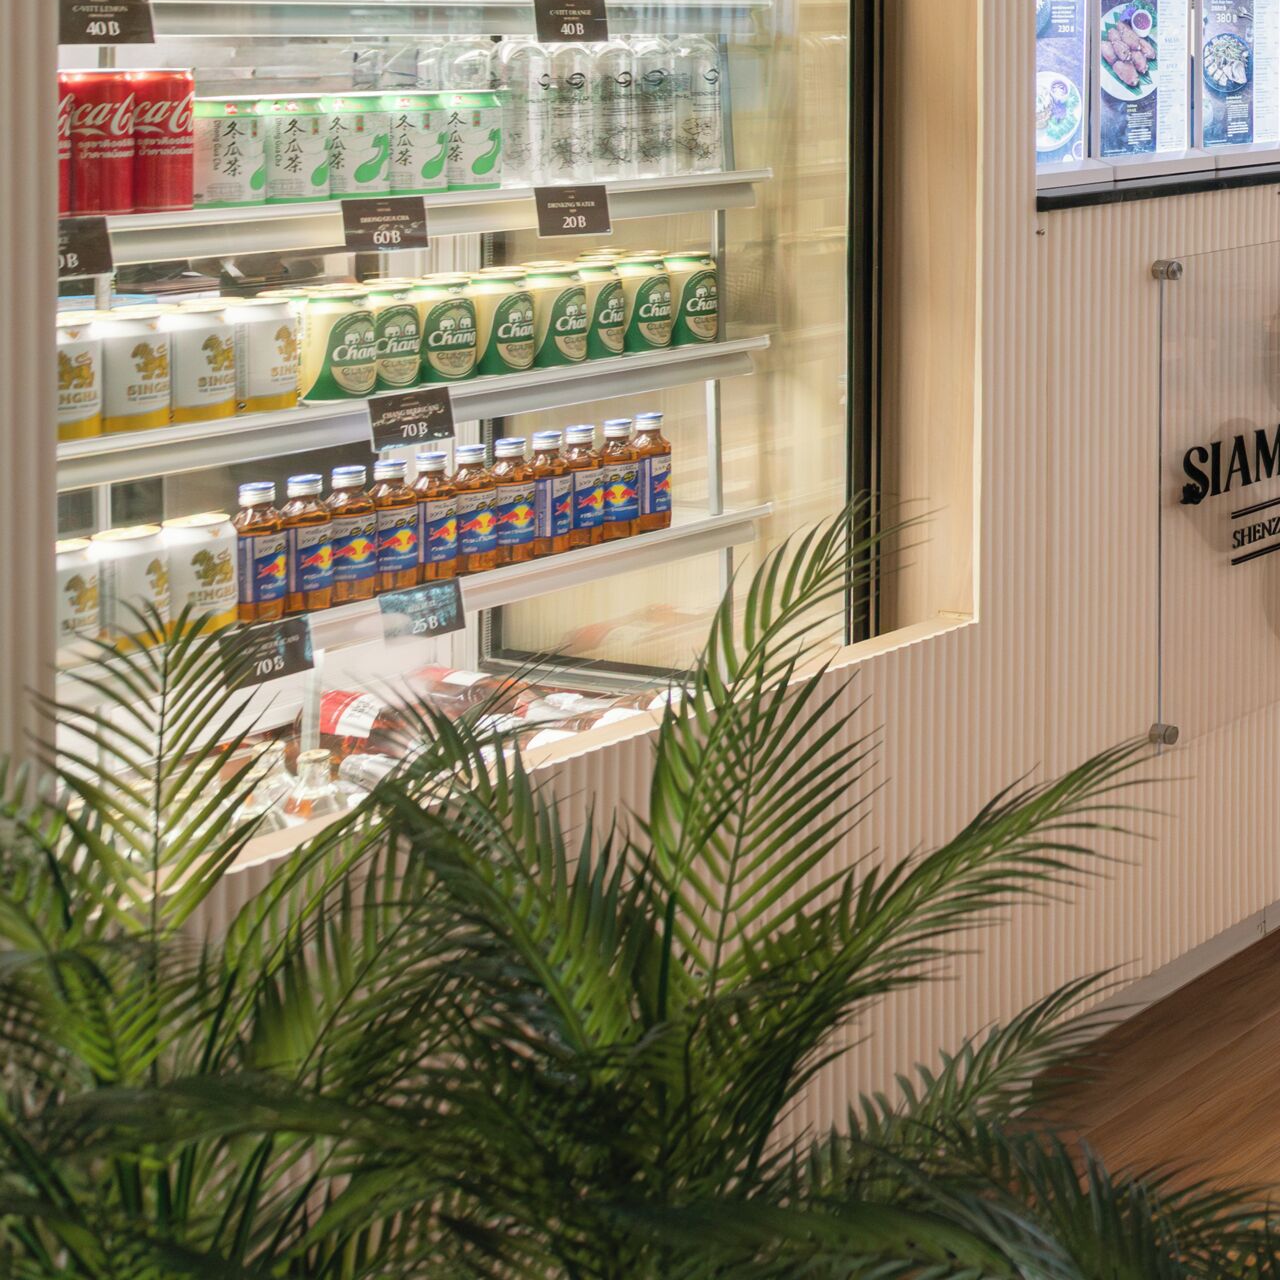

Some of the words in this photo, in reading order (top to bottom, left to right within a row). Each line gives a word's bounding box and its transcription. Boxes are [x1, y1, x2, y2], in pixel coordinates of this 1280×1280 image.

[1216, 12, 1232, 23] 380
[1057, 25, 1070, 33] 230
[283, 118, 307, 174] 冬瓜茶
[328, 116, 350, 171] 冬瓜茶
[394, 113, 417, 167] 冬瓜茶
[447, 111, 468, 163] 冬瓜茶
[222, 120, 246, 177] 冬瓜茶
[598, 308, 624, 324] Cha
[428, 328, 477, 347] Chang
[498, 321, 534, 339] Chan
[375, 336, 420, 354] Chang
[271, 365, 298, 377] SING
